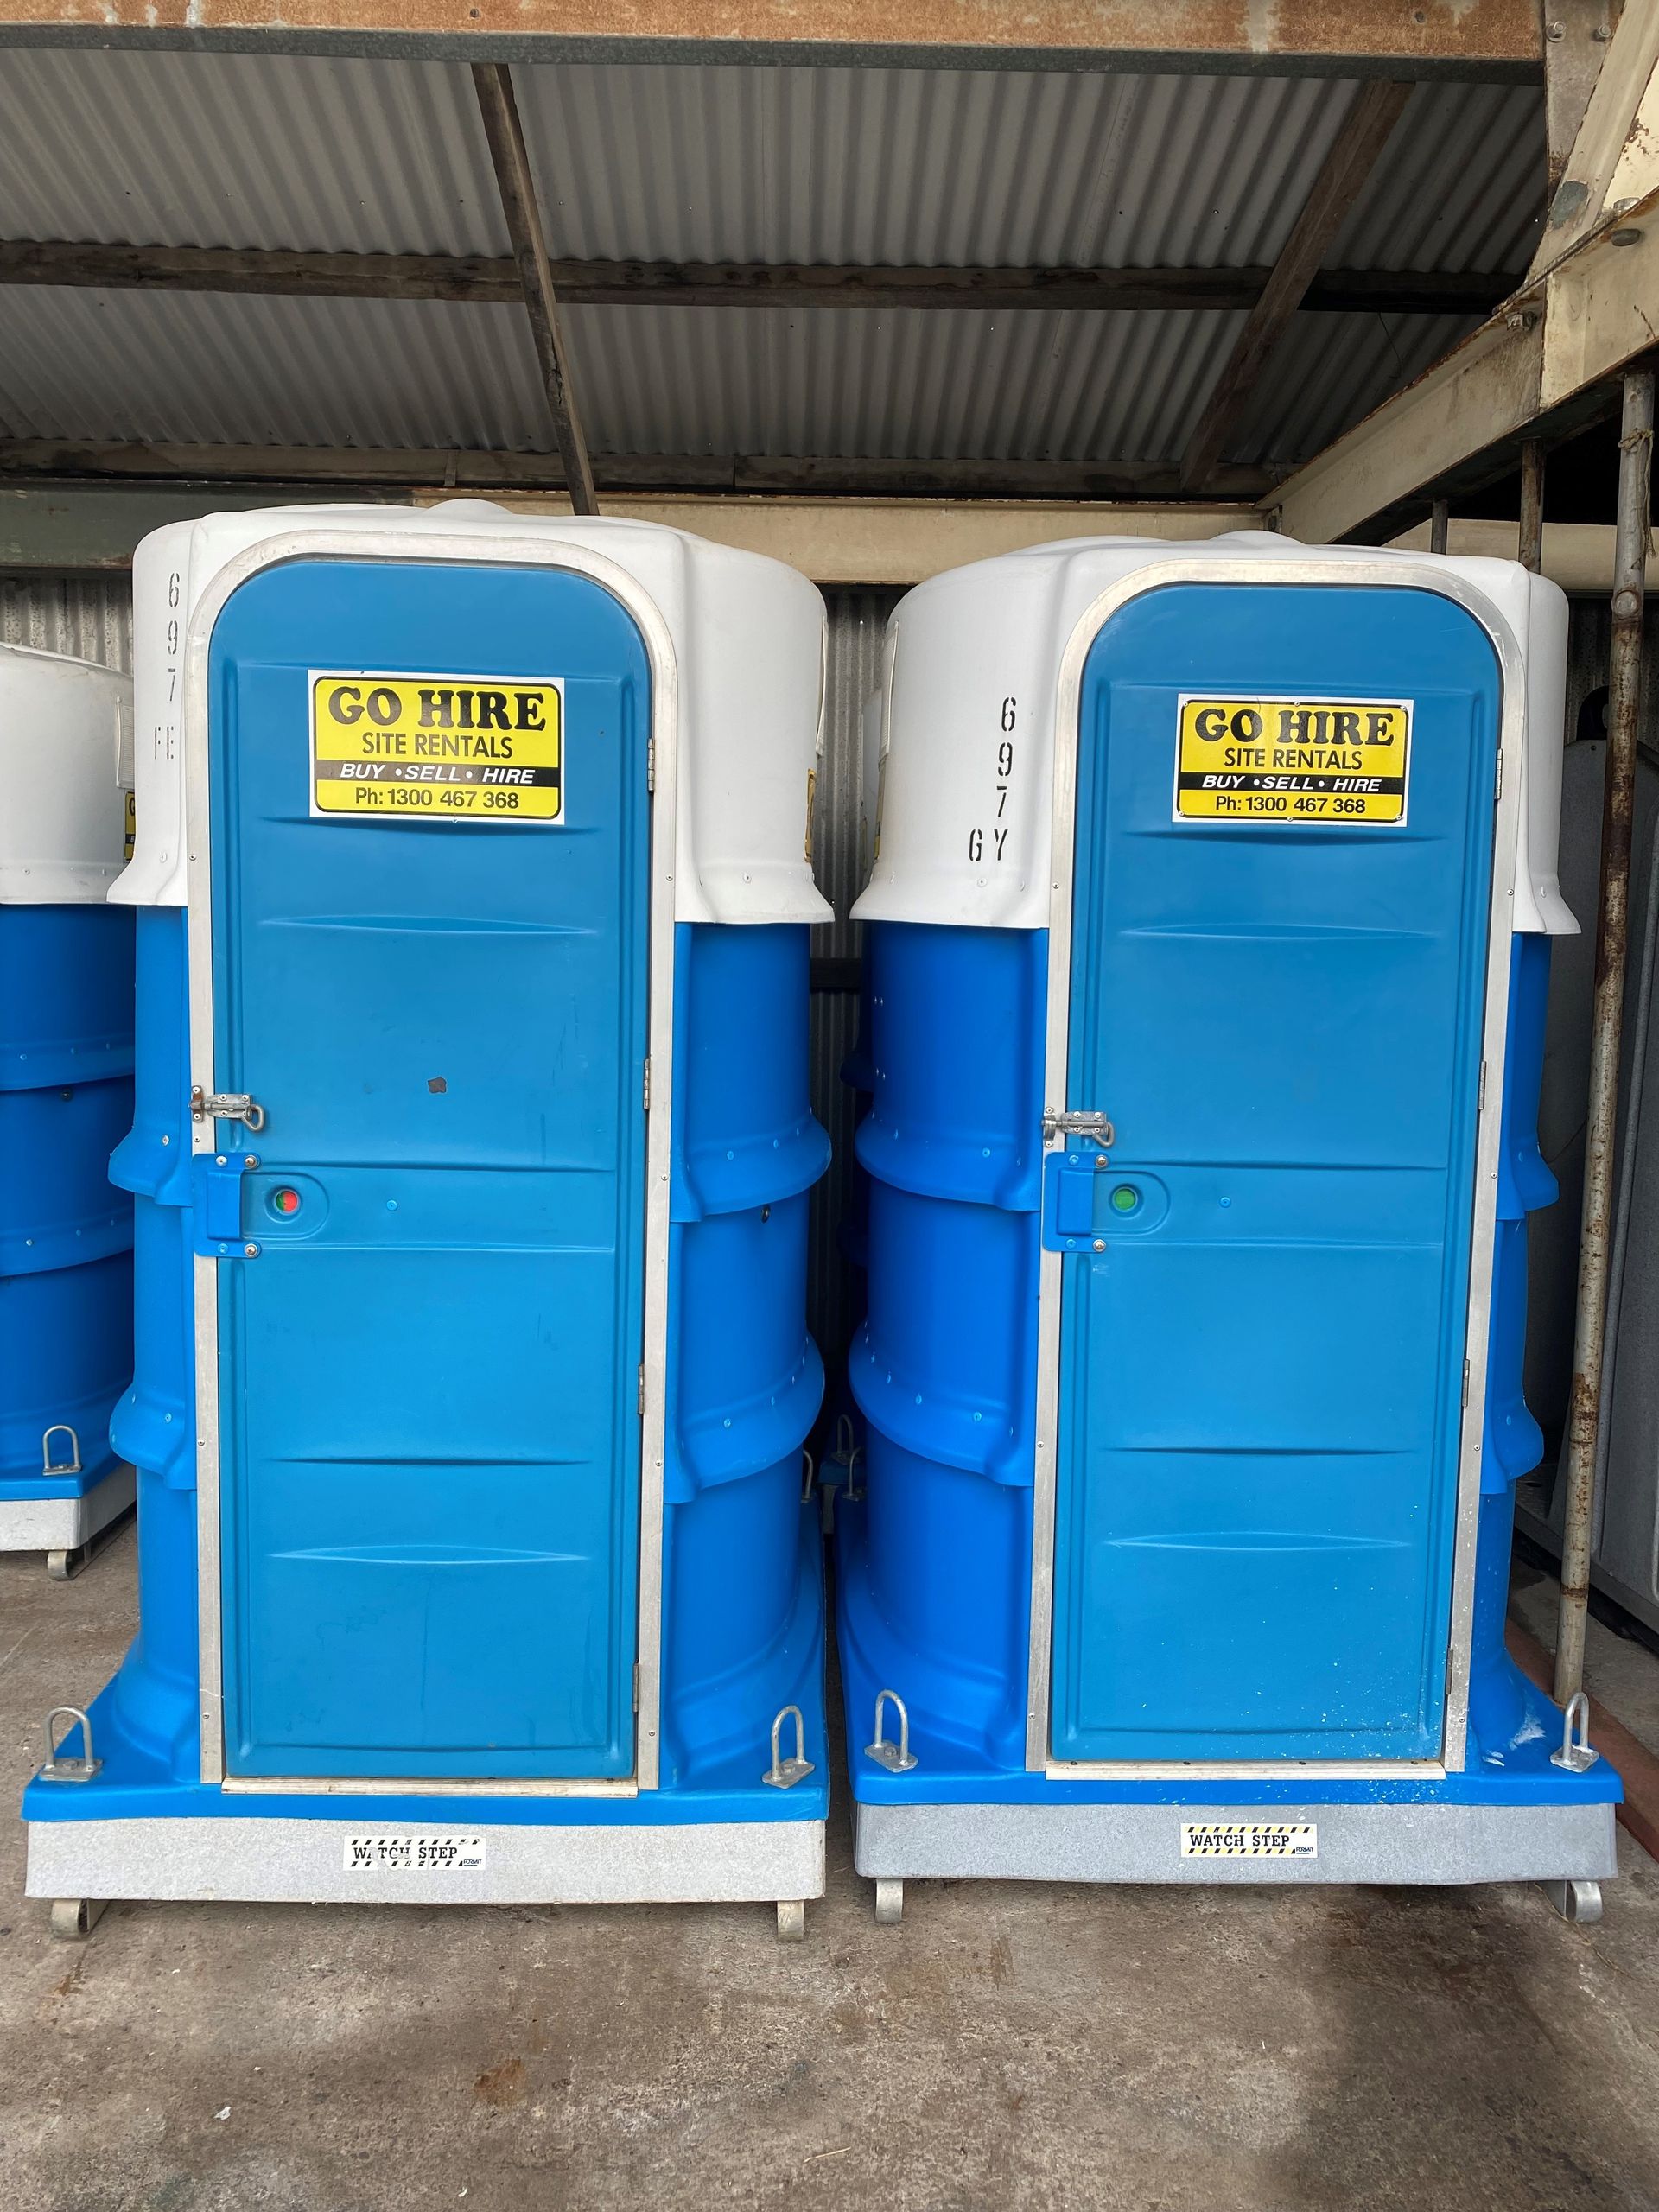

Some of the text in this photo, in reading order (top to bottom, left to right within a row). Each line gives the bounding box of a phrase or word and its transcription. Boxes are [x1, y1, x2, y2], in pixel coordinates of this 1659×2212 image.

[328, 686, 546, 731] GO HIRE
[1195, 709, 1395, 747] GO HIRE
[362, 732, 513, 759] SITE RENTALS
[1224, 747, 1363, 770] SITE RENTALS
[340, 763, 386, 779] BUY
[482, 766, 537, 785] HIRE
[1202, 775, 1246, 789] BUY
[1332, 778, 1382, 792] HIRE
[355, 787, 519, 810] Ph: 1300 467 368
[1216, 796, 1366, 814] Ph: 1300 467 368
[1189, 1834, 1290, 1847] WATCH STEP
[418, 1847, 458, 1859] STEP
